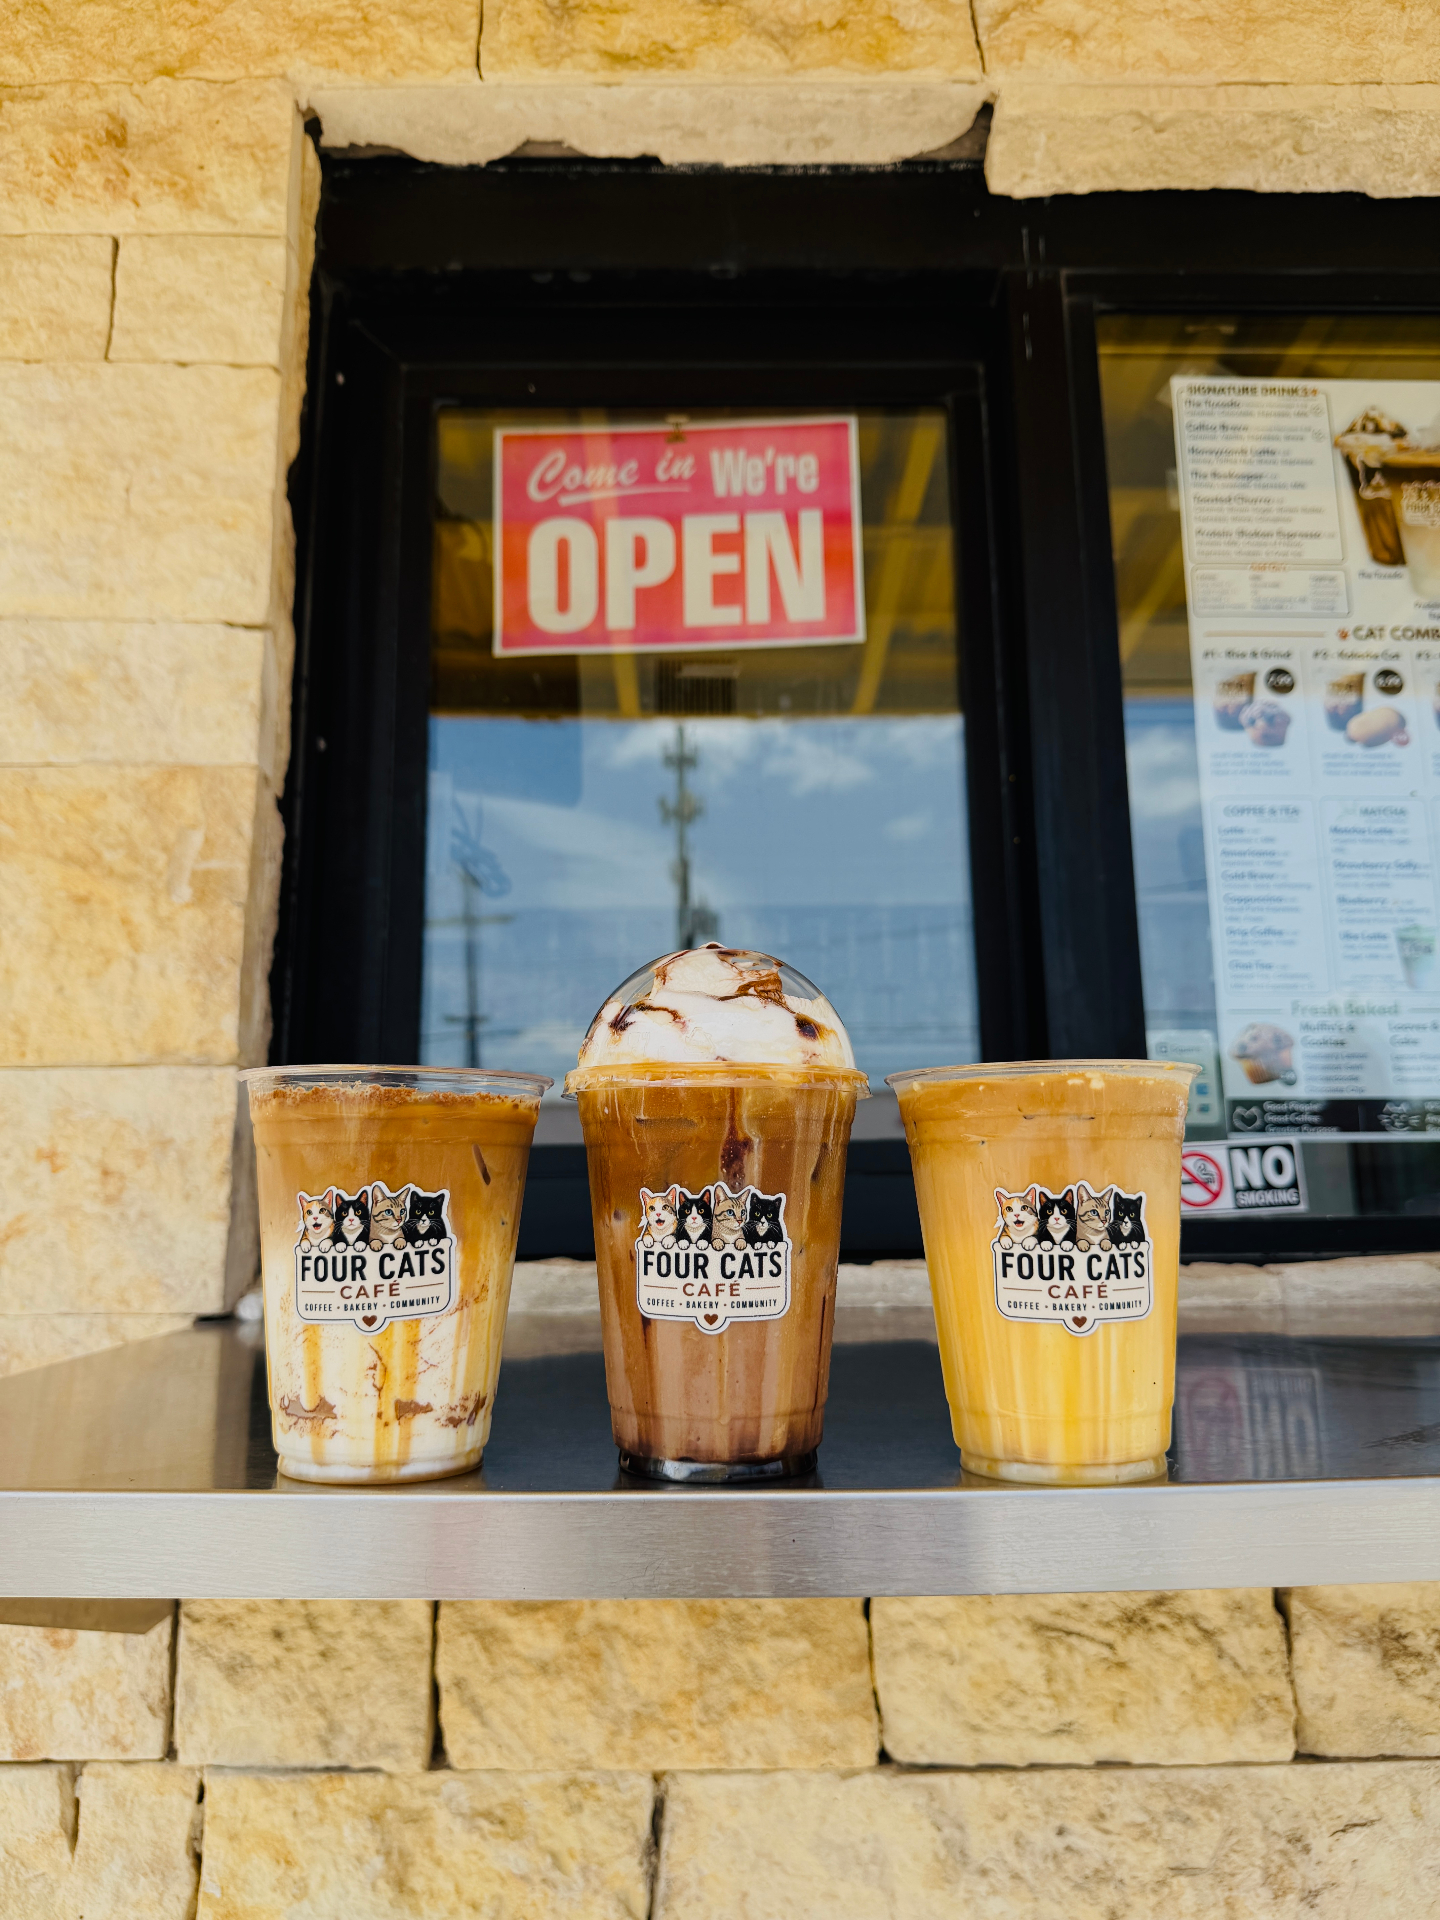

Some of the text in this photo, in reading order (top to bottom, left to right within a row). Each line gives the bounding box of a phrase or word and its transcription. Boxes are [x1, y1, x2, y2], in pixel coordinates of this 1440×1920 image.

[1186, 385, 1309, 397] SIGNATURE DRINKS
[527, 447, 819, 502] Come in We're
[527, 507, 826, 634] OPEN
[1352, 626, 1386, 641] CAT
[1223, 804, 1300, 817] COFFEE & TEA
[1360, 806, 1406, 817] MATCHA
[1291, 1000, 1400, 1017] Fresh Baked
[1229, 1145, 1297, 1190] NO
[1236, 1188, 1300, 1207] SMOKING
[301, 1247, 446, 1282] FOUR CATS
[643, 1250, 782, 1280] FOUR CATS
[1001, 1251, 1146, 1281] FOUR CATS
[340, 1280, 401, 1300] CAFÉ
[682, 1280, 741, 1297] CAFÉ
[1048, 1281, 1109, 1299] CAFÉ
[305, 1296, 440, 1312] COFFEE BAKERY COMMUNITY
[647, 1298, 777, 1309] COFFEE BAKERY COMMUNITY
[1007, 1299, 1142, 1311] COFFEE BAKERY COMMUNITY
